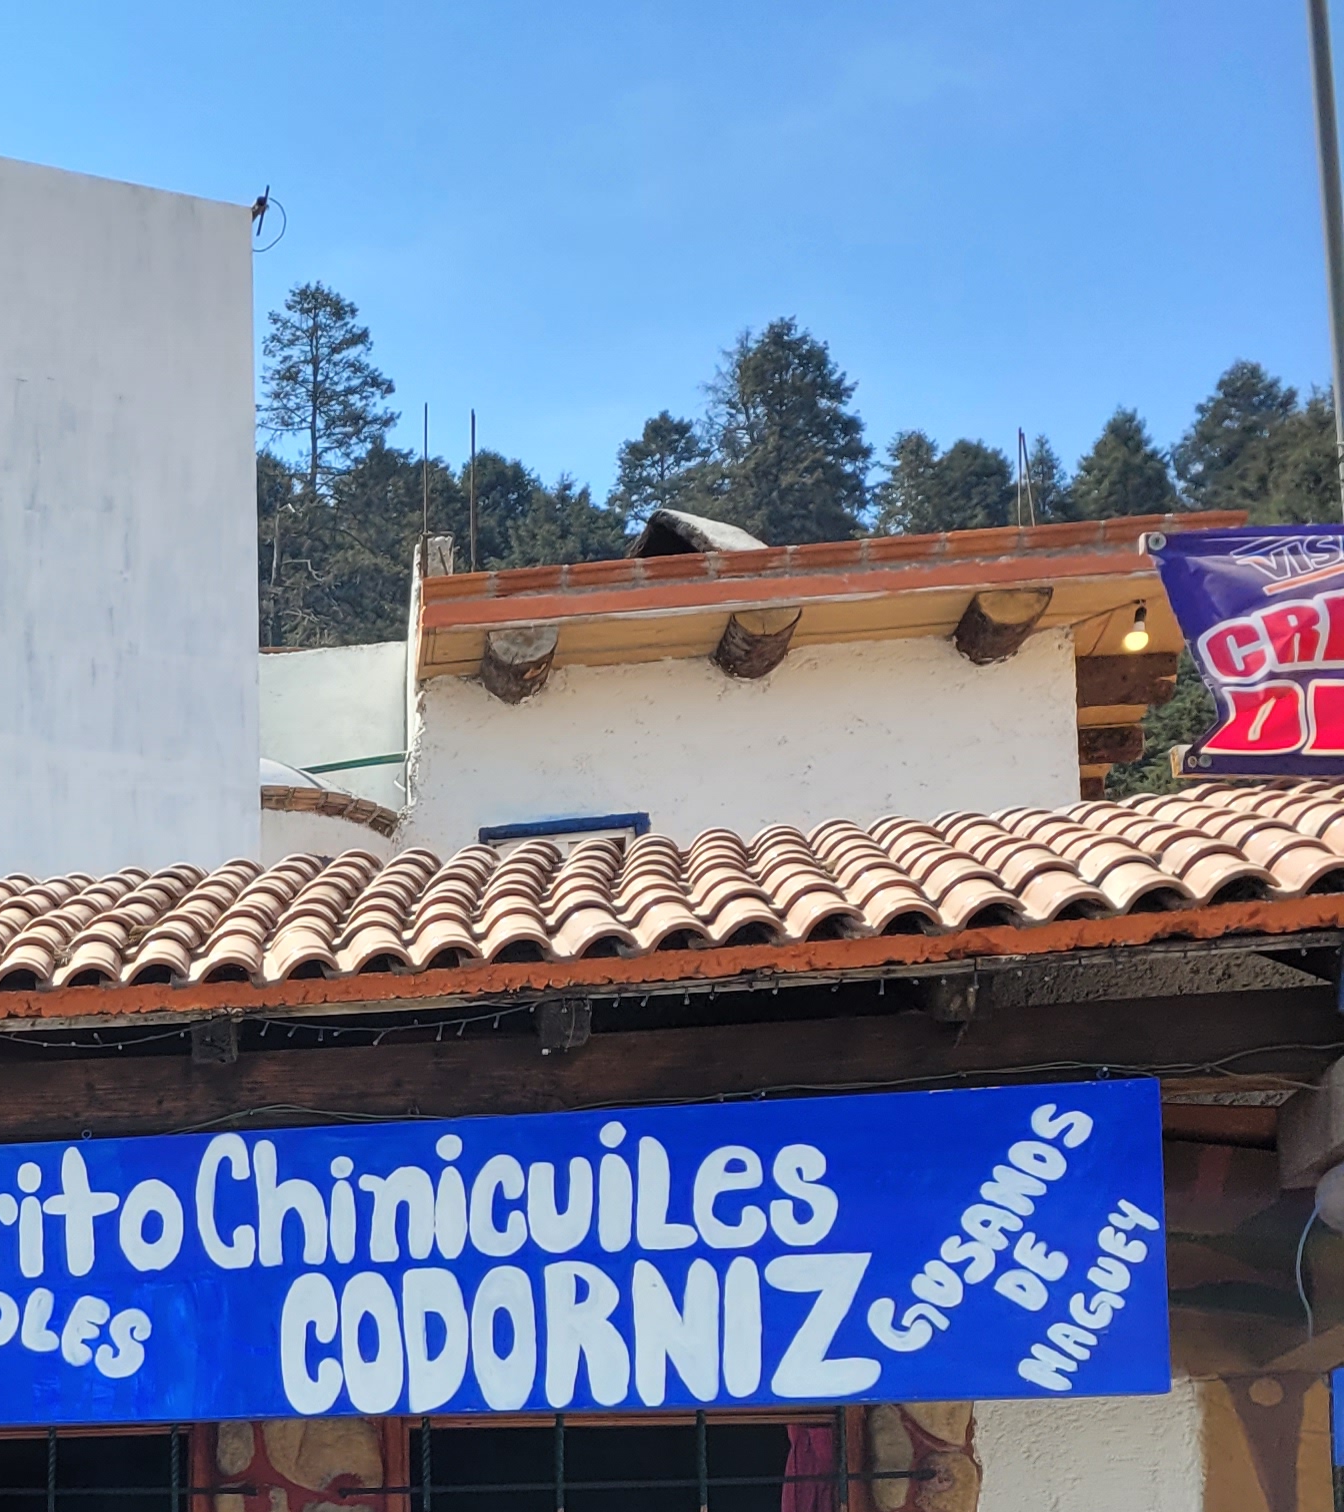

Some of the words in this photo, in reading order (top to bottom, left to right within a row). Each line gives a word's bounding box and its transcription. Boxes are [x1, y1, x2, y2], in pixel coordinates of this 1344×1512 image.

[1234, 536, 1344, 580] VIS
[196, 1121, 839, 1270] Chinicuiles
[867, 1103, 1094, 1353] GUSANOS
[994, 1232, 1068, 1312] DE
[281, 1253, 882, 1414] CODORNIZ
[1018, 1199, 1160, 1391] MAGUEY
